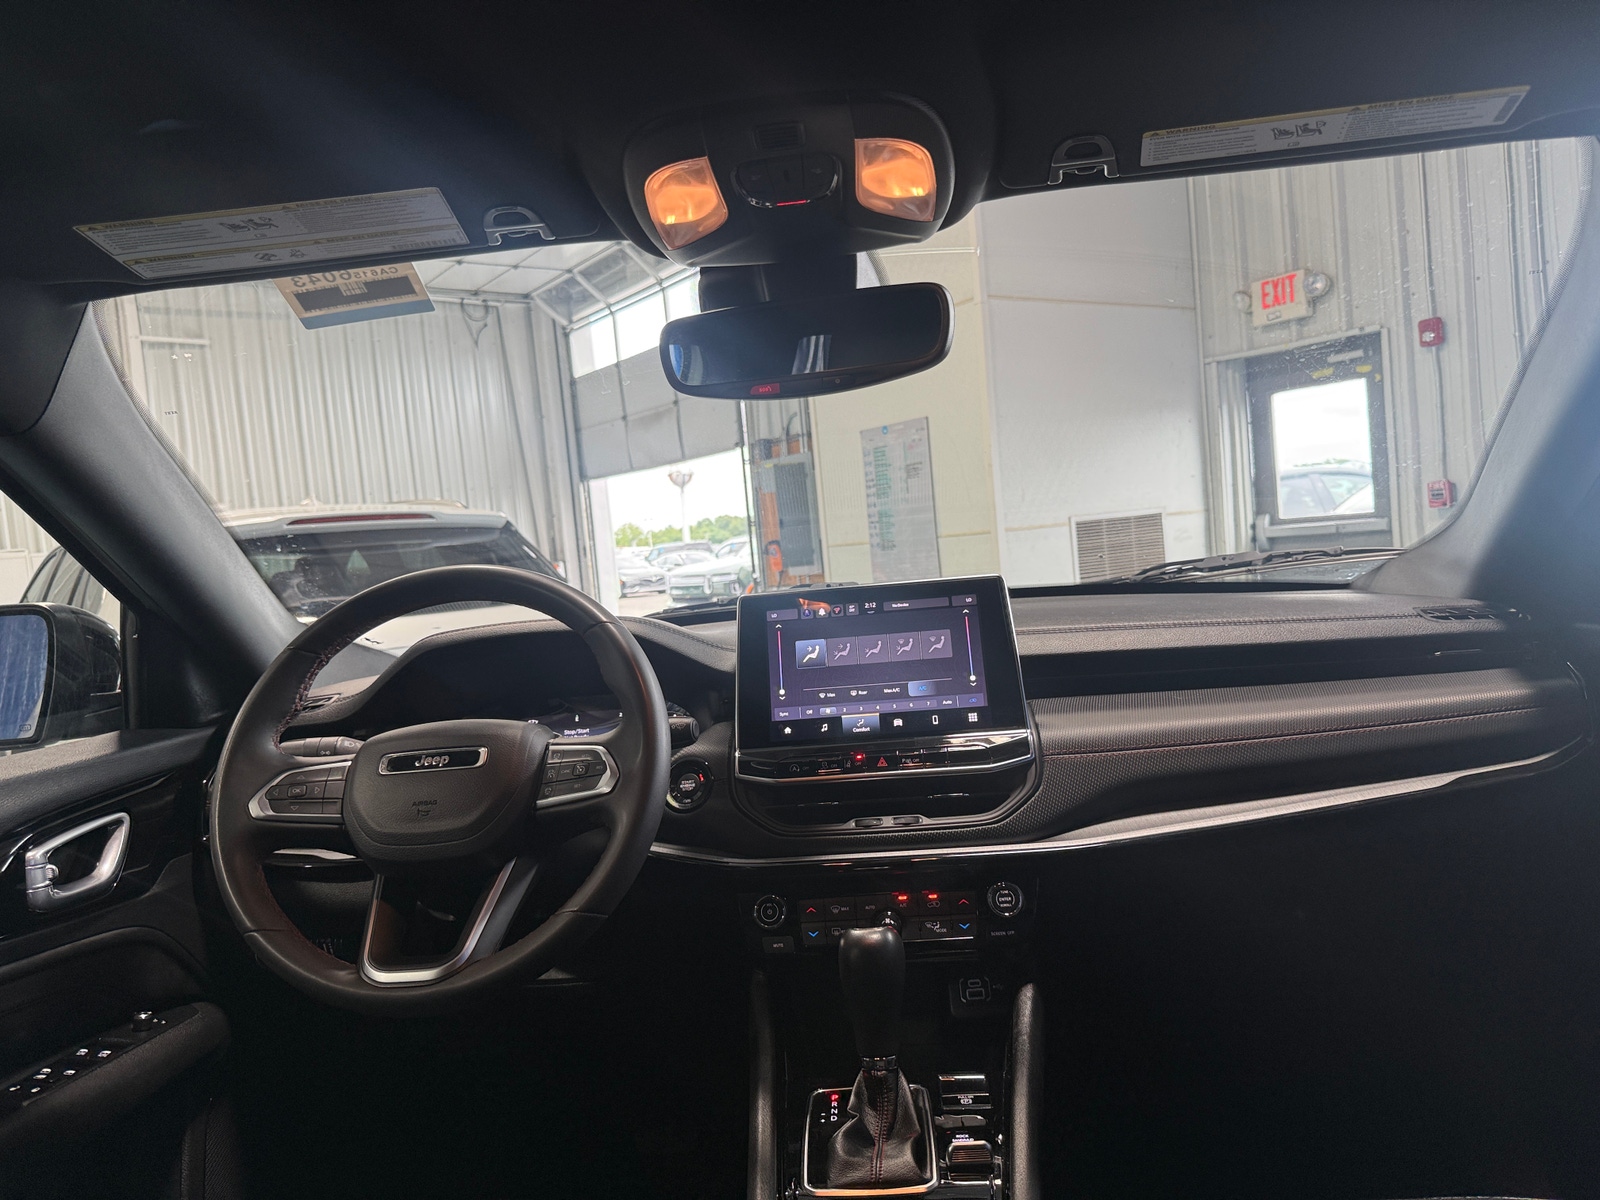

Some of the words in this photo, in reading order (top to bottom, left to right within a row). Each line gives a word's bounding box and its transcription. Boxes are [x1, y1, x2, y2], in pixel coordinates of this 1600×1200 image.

[1166, 125, 1216, 135] WARNING
[102, 220, 153, 229] WARNING
[147, 254, 195, 263] WARNING
[1261, 273, 1297, 310] EXIT
[414, 755, 450, 767] Jeep
